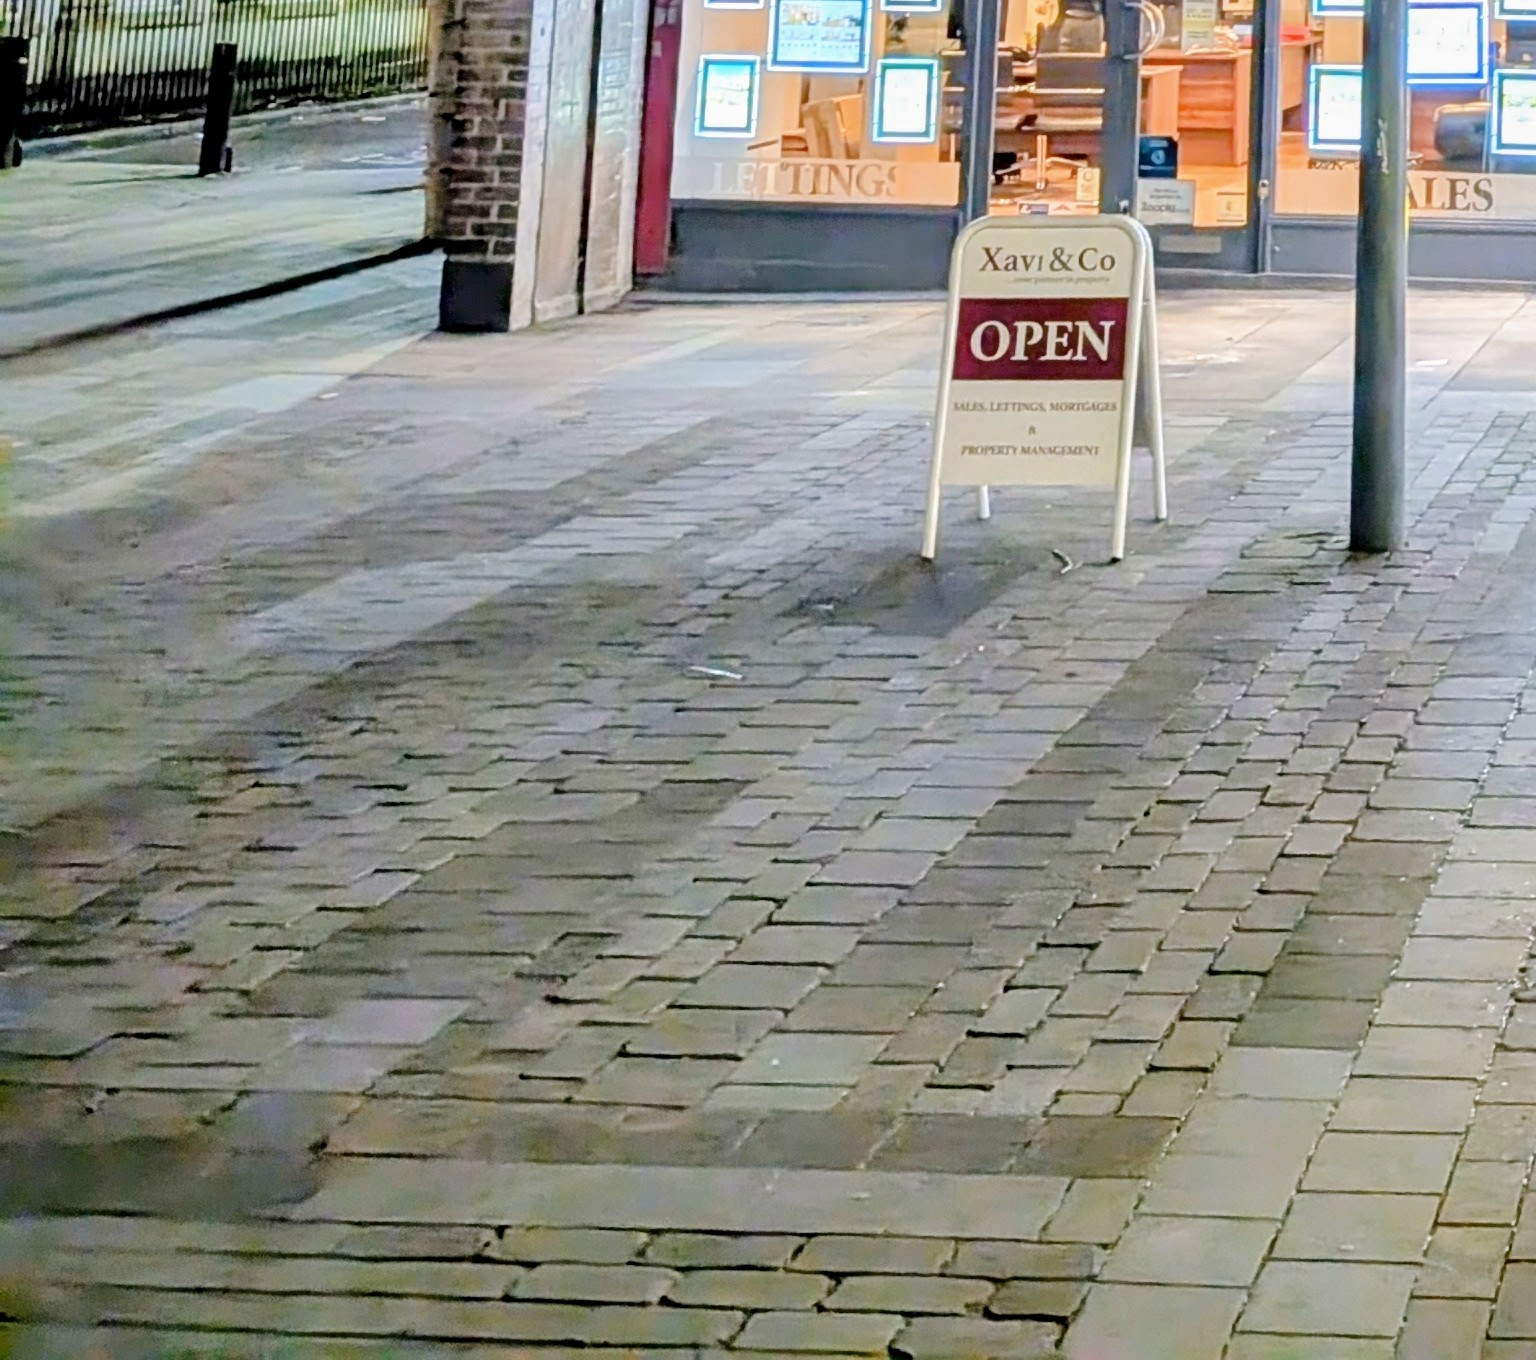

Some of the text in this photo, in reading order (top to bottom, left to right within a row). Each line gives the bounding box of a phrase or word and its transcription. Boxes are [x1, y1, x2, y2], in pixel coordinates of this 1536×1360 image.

[970, 320, 1116, 362] OPEN
[1049, 401, 1117, 412] MORTGAGES
[961, 445, 1100, 456] PROPERTY MANAGEMENT
